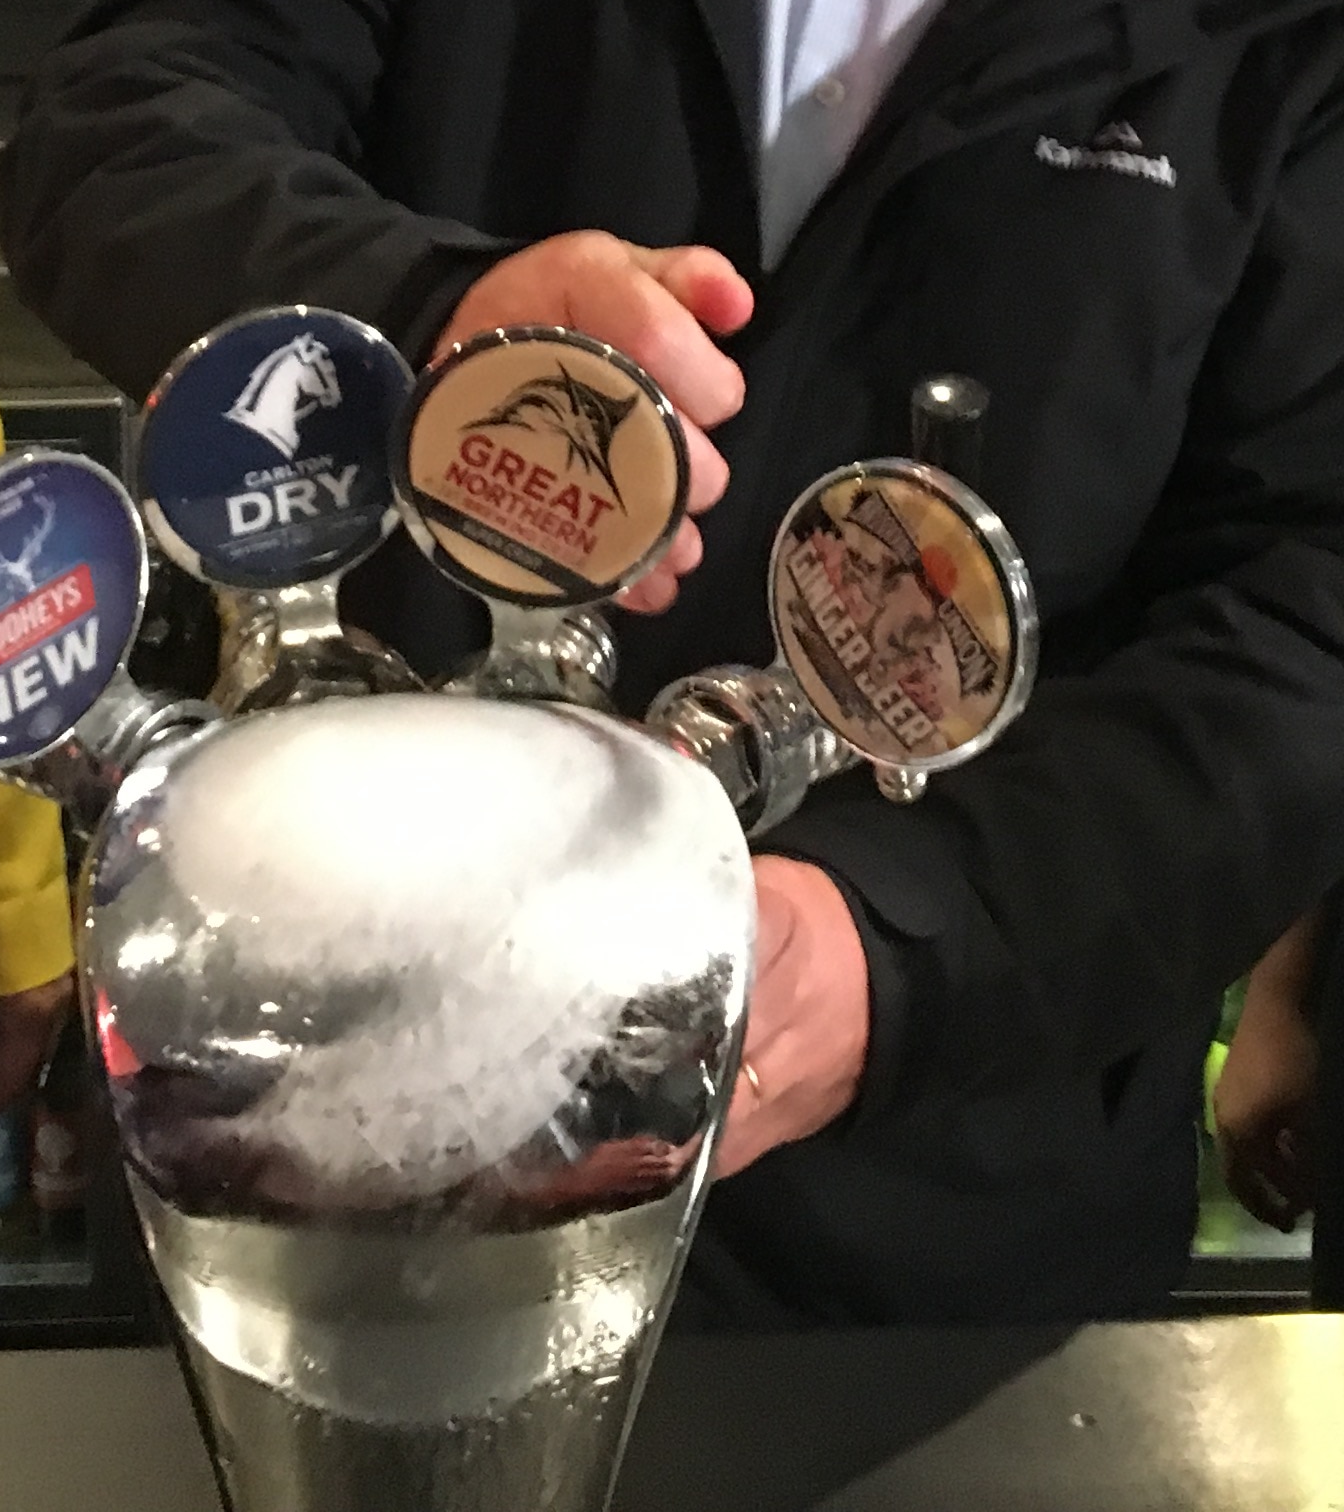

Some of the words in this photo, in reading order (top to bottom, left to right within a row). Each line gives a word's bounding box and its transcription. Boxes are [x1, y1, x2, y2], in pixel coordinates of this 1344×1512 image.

[227, 464, 358, 537] DRY
[443, 461, 599, 557] NORTHERN
[459, 432, 617, 529] GREAT
[788, 538, 873, 672] GINGER
